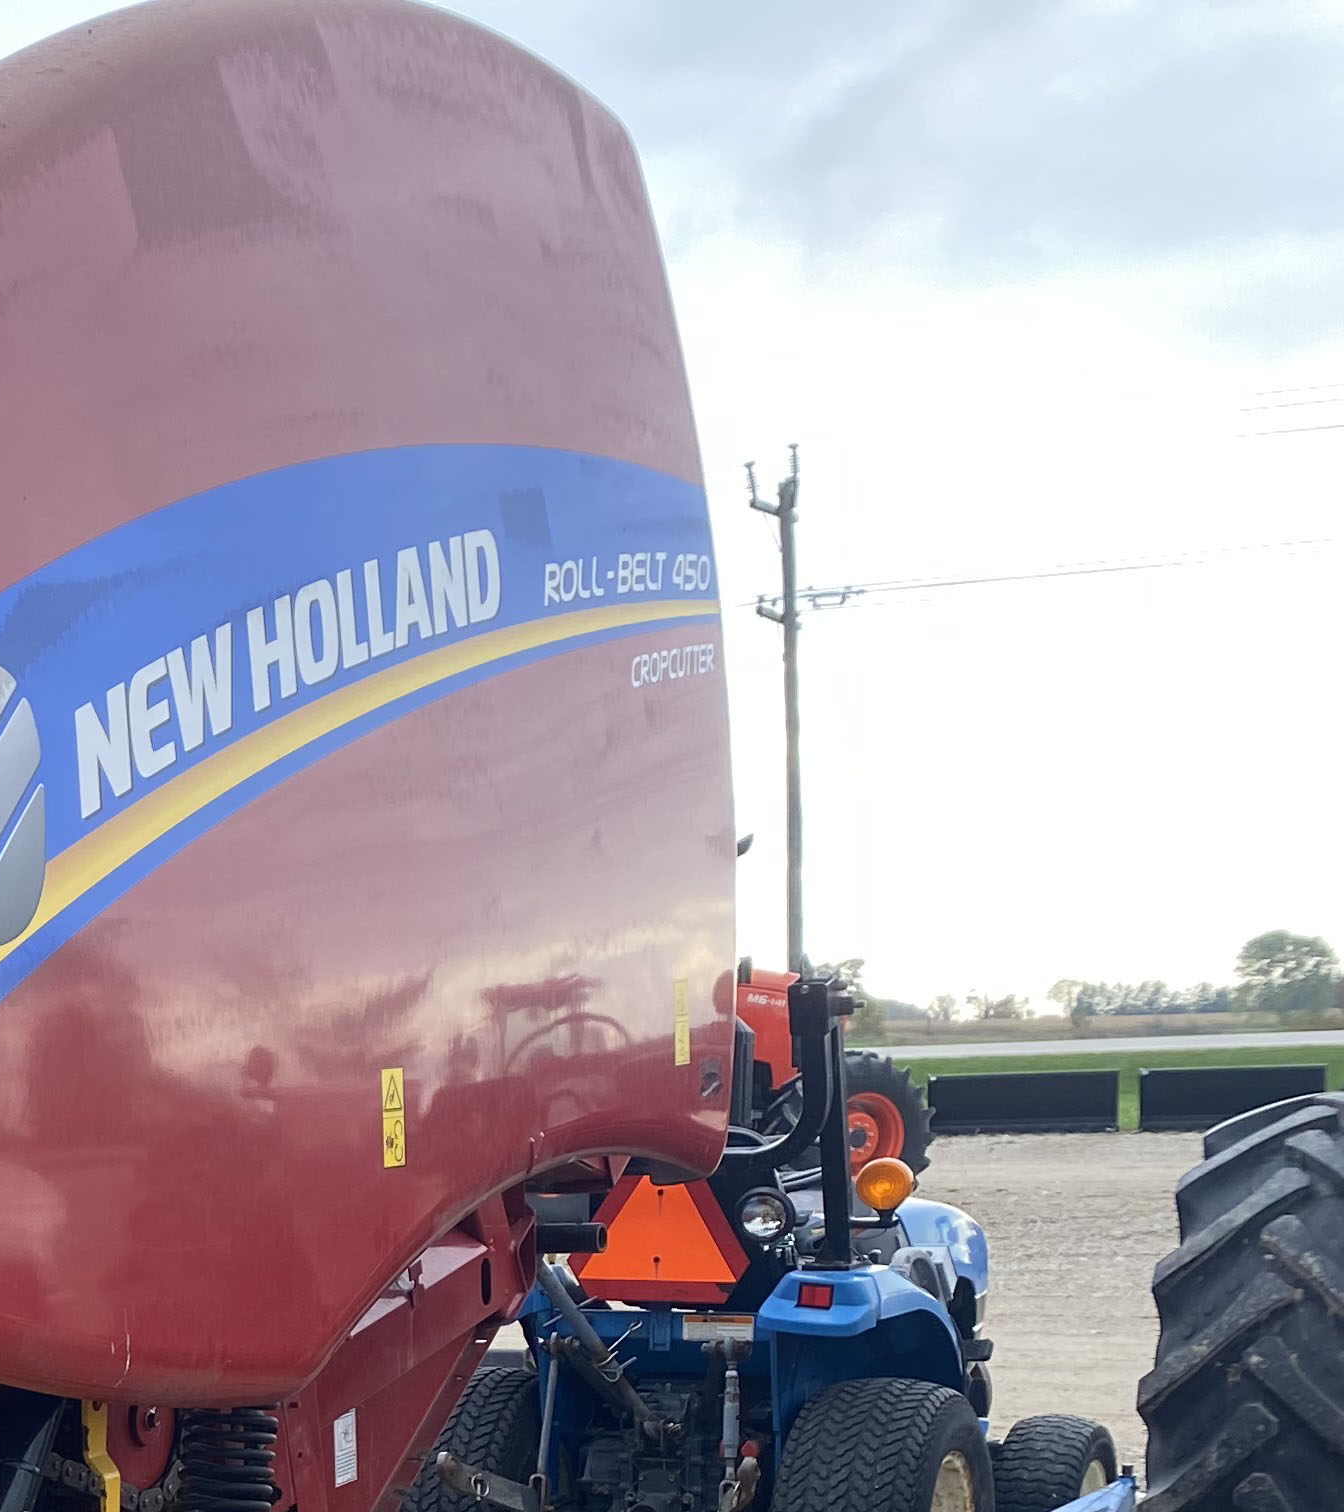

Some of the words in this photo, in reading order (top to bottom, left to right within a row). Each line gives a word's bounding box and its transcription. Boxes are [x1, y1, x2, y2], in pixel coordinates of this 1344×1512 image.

[543, 552, 668, 607] ROLL-BELT
[672, 553, 711, 591] 450
[74, 621, 233, 820] NEW
[246, 528, 502, 713] HOLLAND
[631, 643, 715, 688] CROPCUTTER
